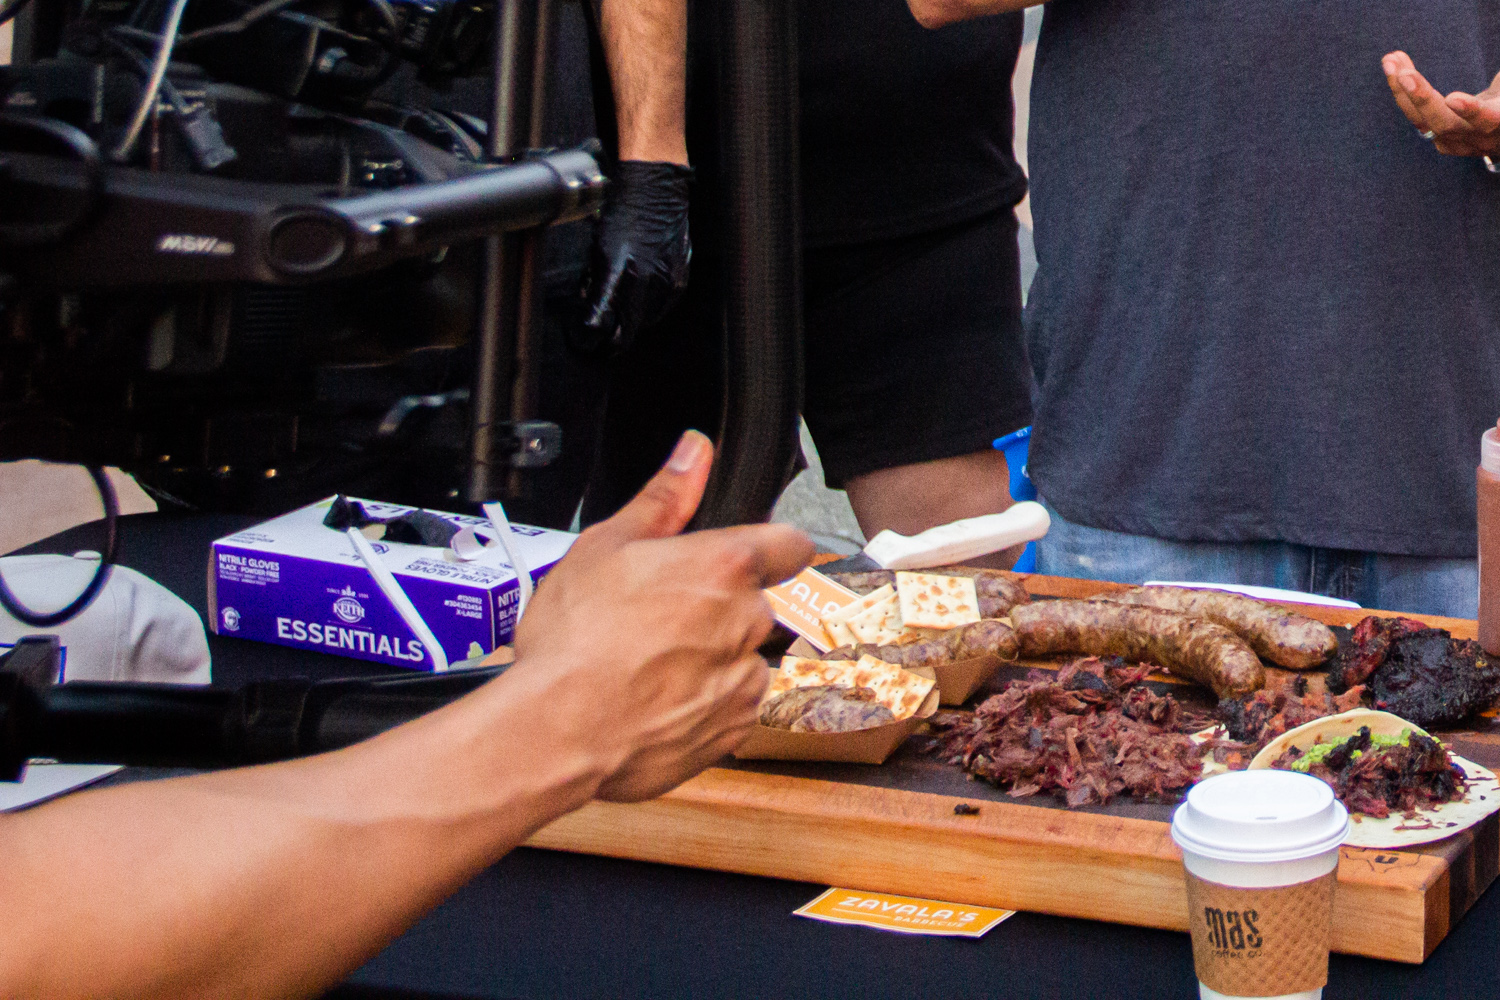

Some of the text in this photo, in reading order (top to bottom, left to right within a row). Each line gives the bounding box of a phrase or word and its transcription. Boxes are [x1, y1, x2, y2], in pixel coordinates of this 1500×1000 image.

[218, 553, 280, 571] NITRILE GLOVES
[276, 616, 425, 662] ESSENTIALS
[838, 895, 980, 922] ZAVALA'S
[893, 914, 967, 928] BARBECUE
[1204, 905, 1264, 950] mas
